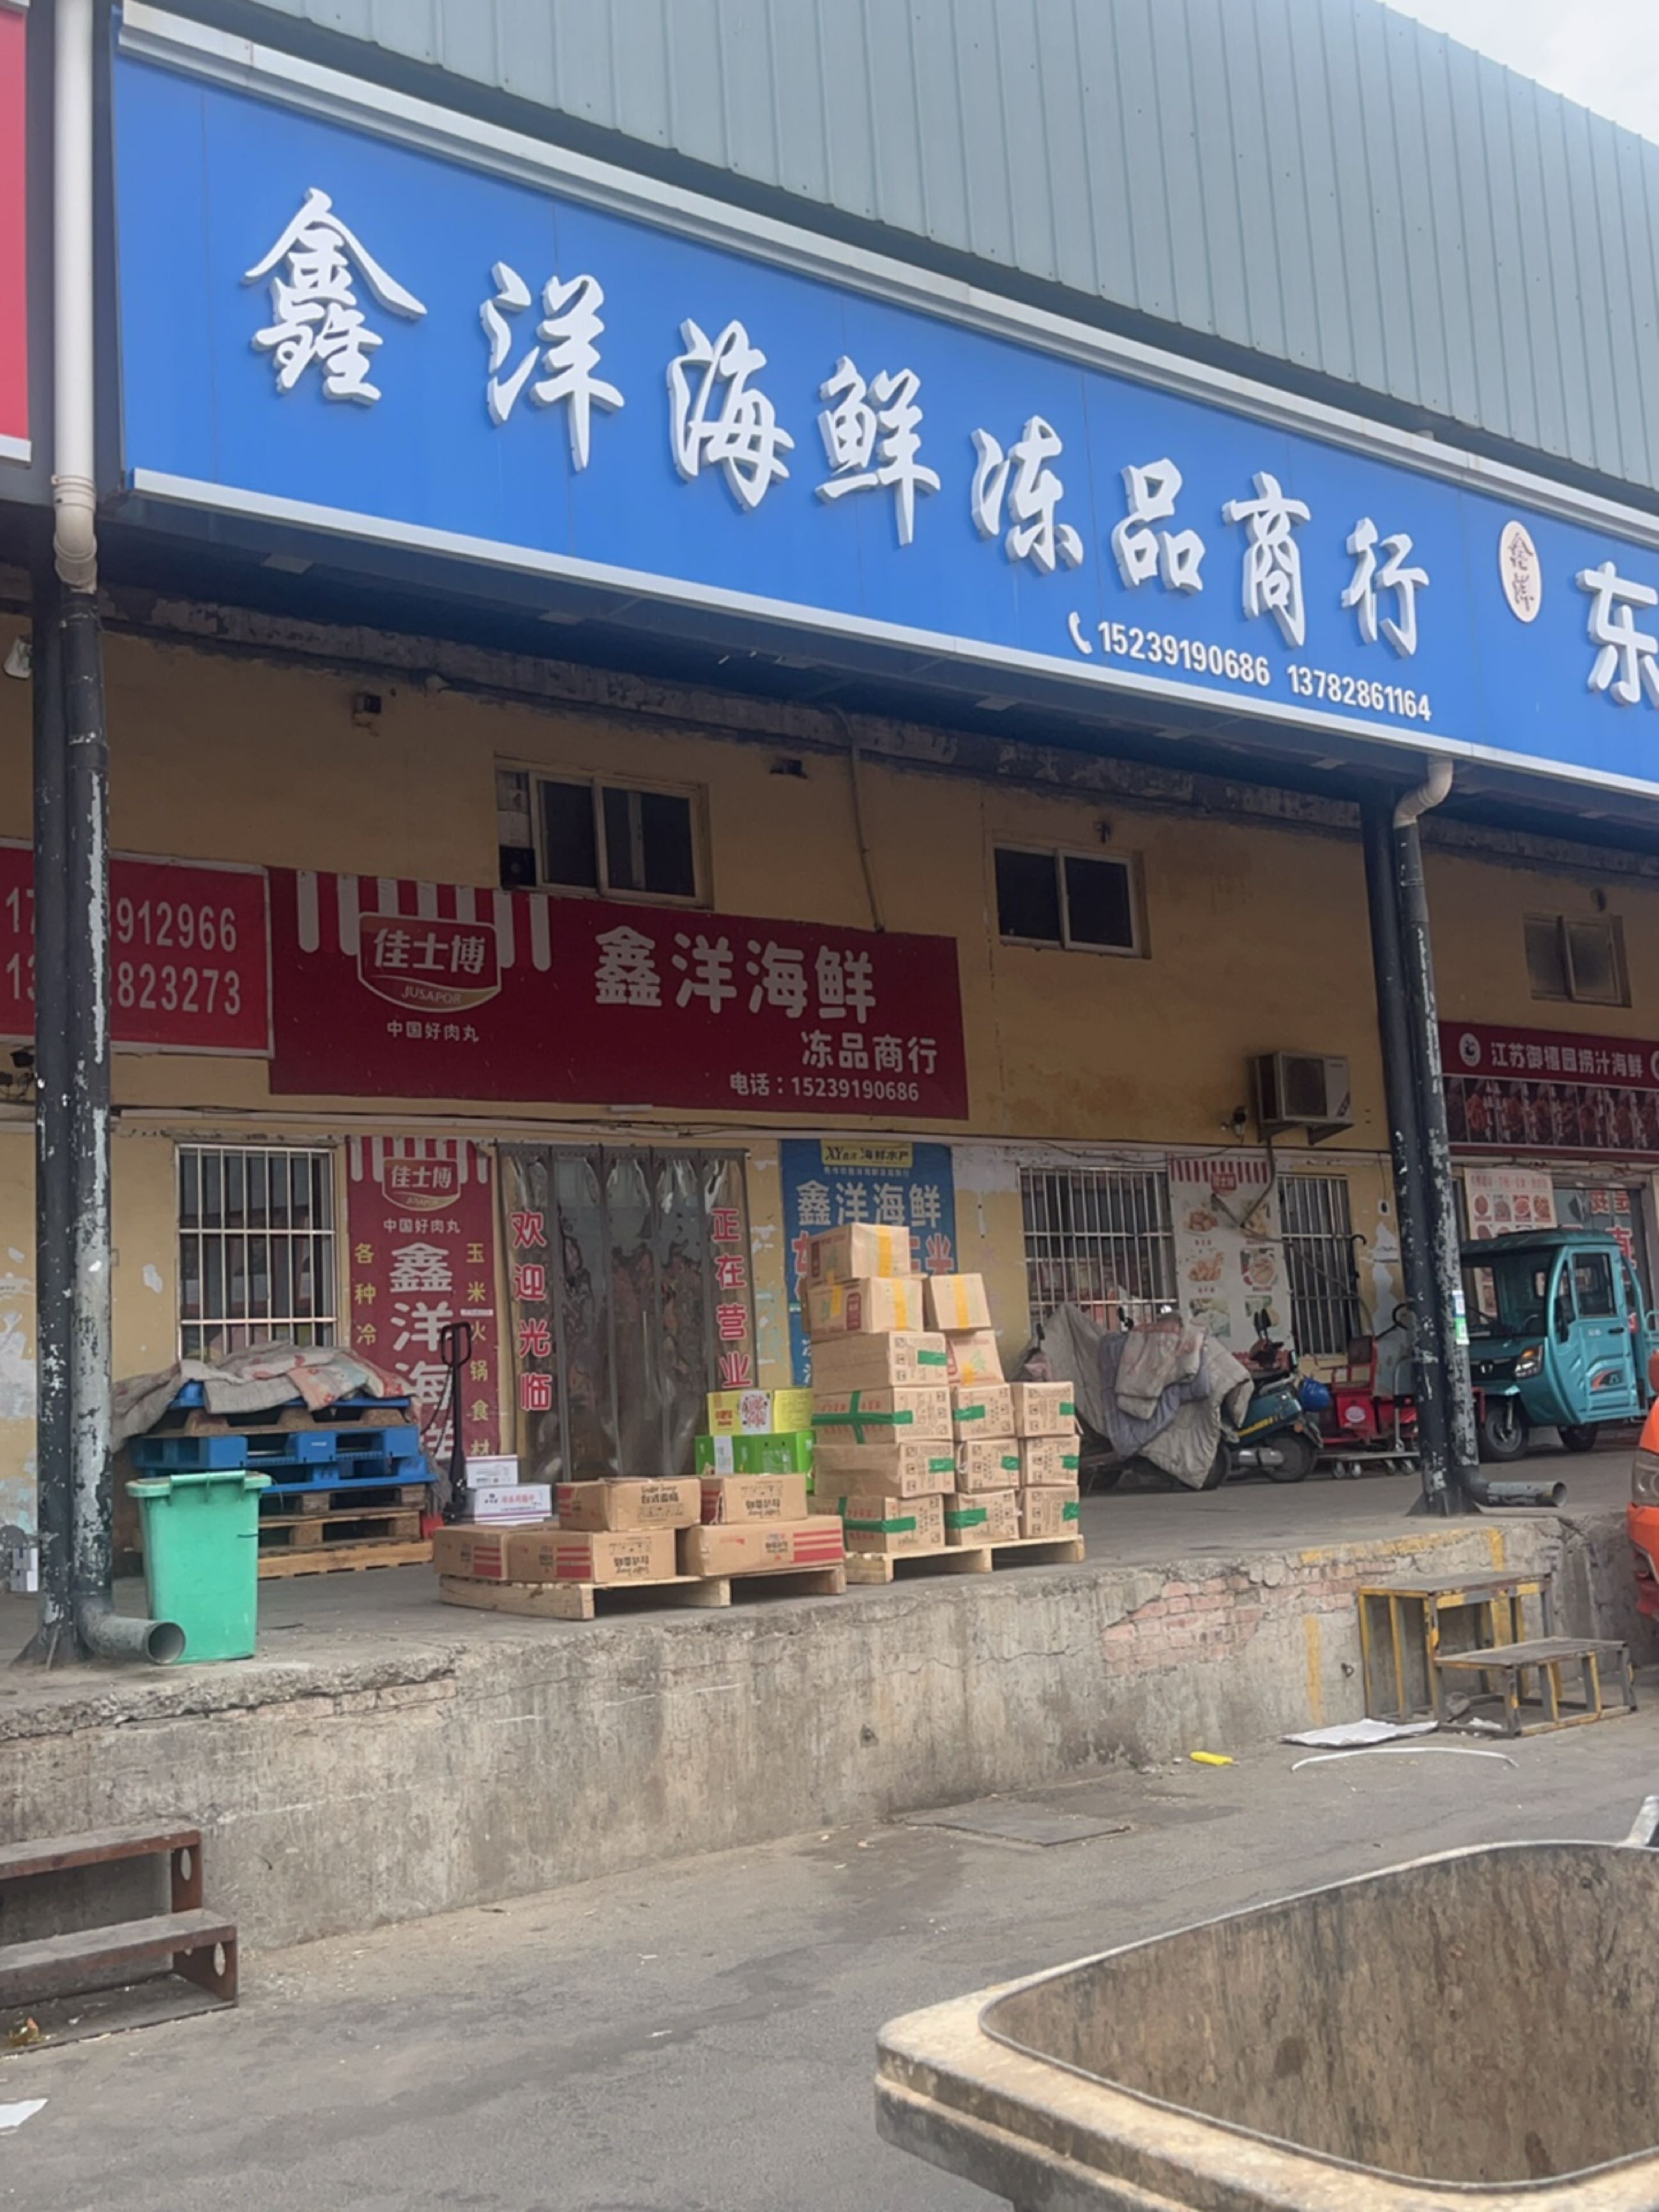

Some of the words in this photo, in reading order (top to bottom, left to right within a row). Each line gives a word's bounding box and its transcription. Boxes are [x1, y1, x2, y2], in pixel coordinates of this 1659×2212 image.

[243, 186, 1431, 658] 鑫洋海鲜冻品商行
[1097, 621, 1271, 686] 15239190686
[1286, 664, 1431, 721] 13782861164
[374, 928, 486, 975] 佳士博
[594, 926, 876, 1024] 鑫洋海鲜
[387, 1020, 480, 1043] 中国好肉丸
[801, 1030, 937, 1075] 冻品商行
[391, 1164, 452, 1190] 佳士博
[383, 1218, 461, 1235] 中国好肉丸
[796, 1179, 941, 1228] 鑫洋海鲜
[511, 1209, 552, 1412] 欢迎光临
[710, 1207, 753, 1390] 正在营业
